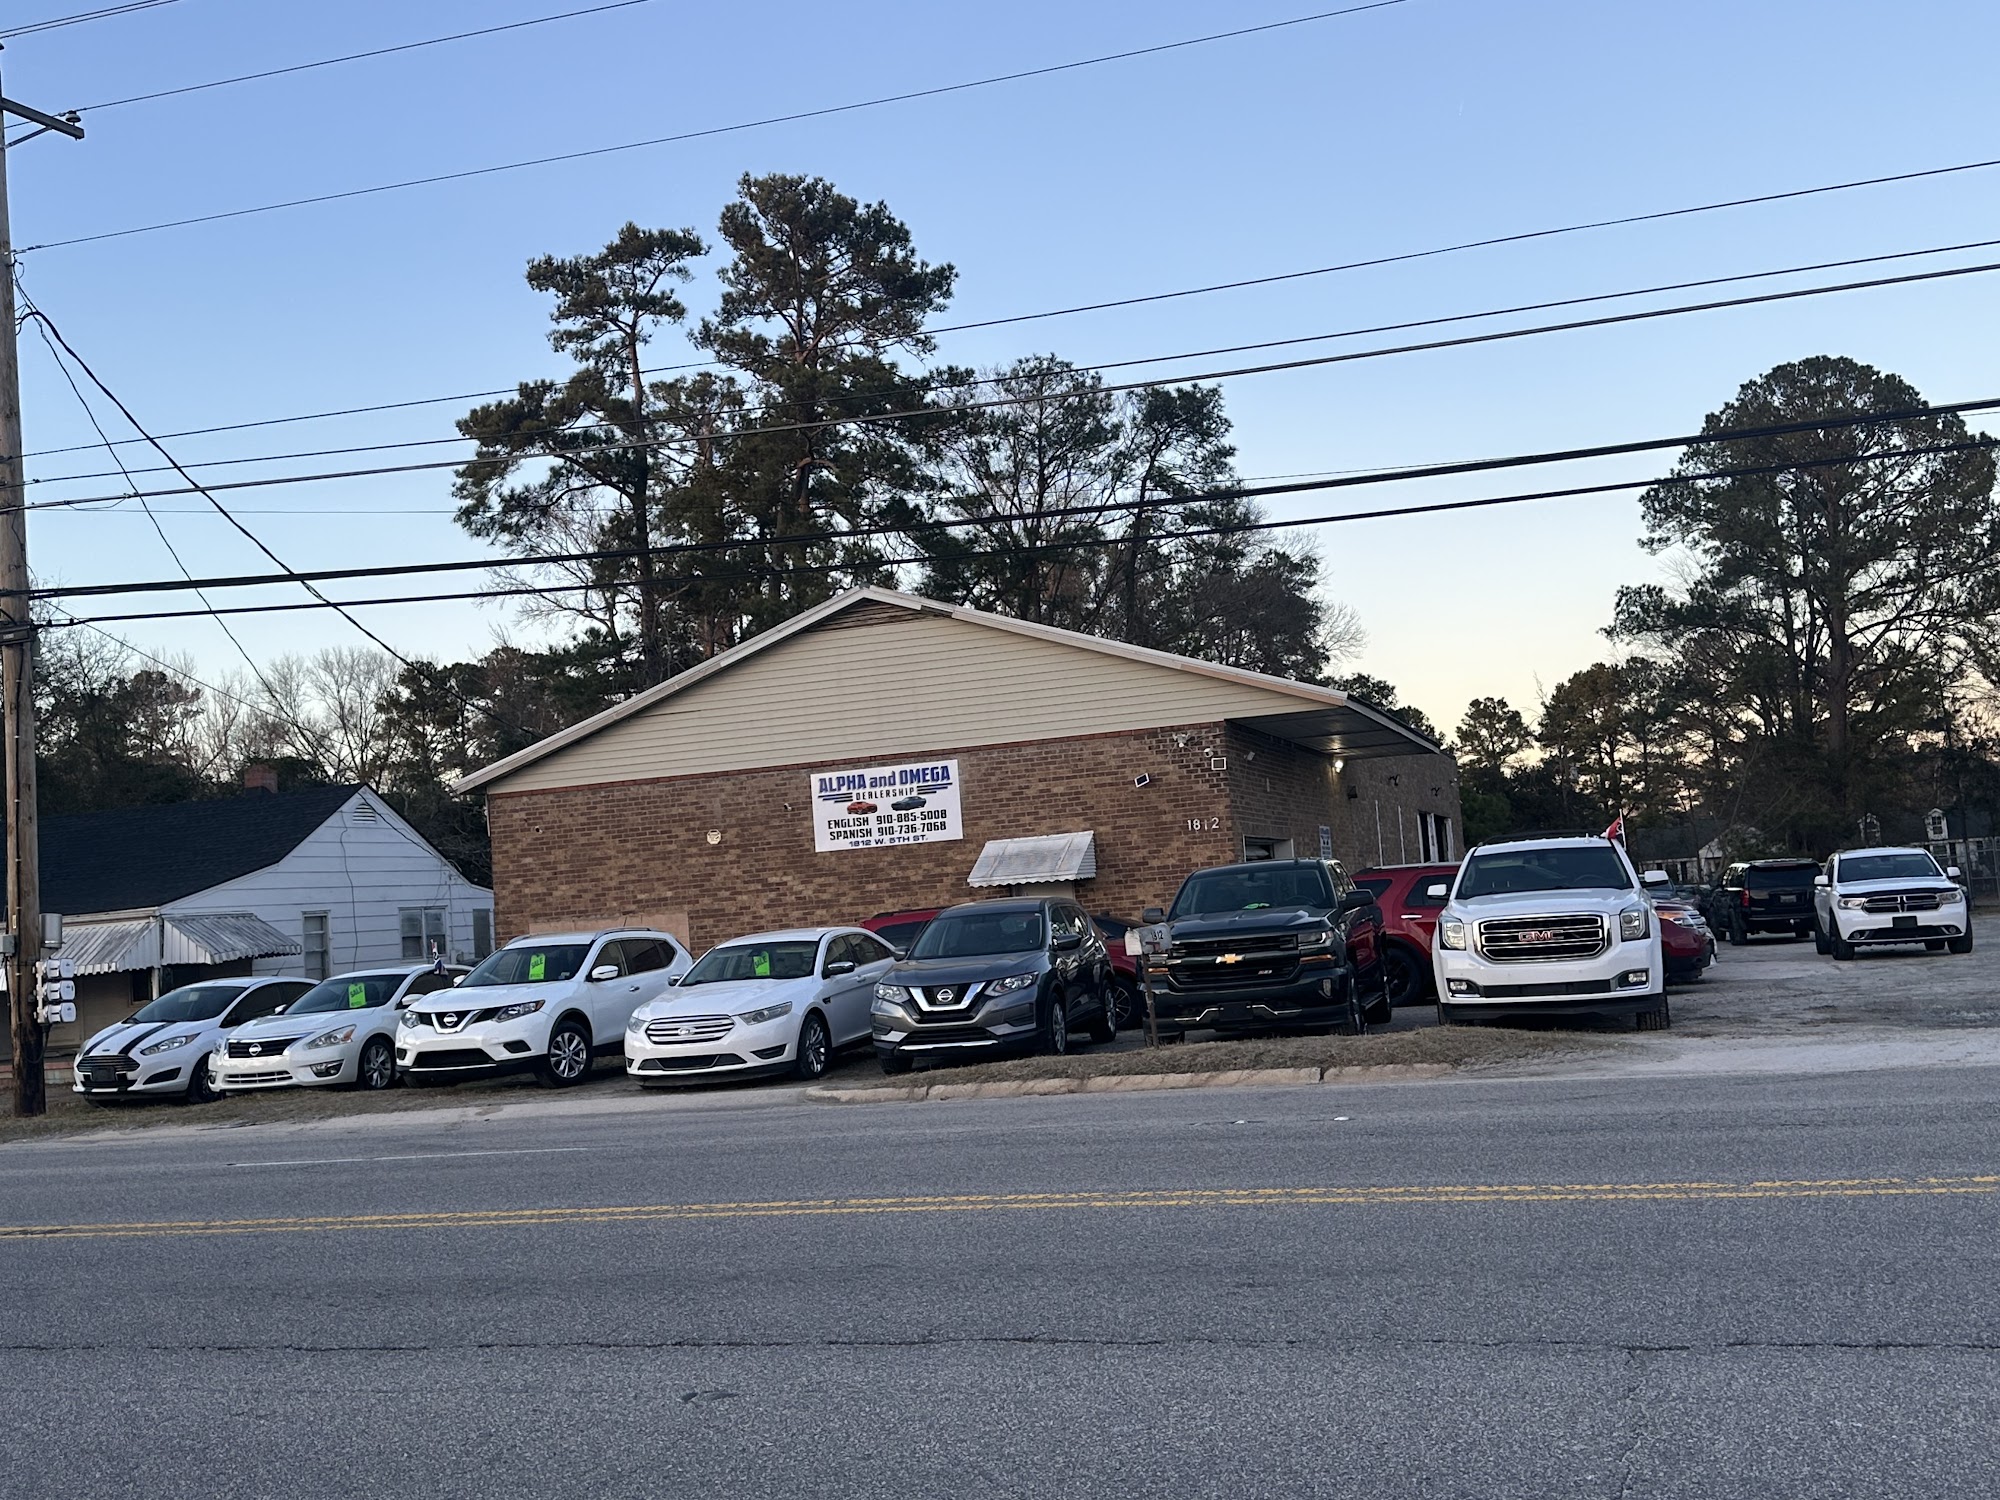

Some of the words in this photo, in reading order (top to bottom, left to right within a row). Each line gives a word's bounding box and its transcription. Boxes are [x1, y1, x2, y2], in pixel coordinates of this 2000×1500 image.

[818, 774, 867, 793] ALPHA
[869, 771, 896, 788] and
[899, 765, 951, 785] OMEGA
[855, 787, 915, 801] DEALERSHIP
[827, 817, 869, 829] ENGLISH
[876, 809, 947, 825] 910-885-5008
[1187, 816, 1220, 831] 1812
[829, 828, 873, 841] SPANISH
[877, 821, 947, 836] 910-736-7068
[848, 839, 872, 847] 1812
[874, 837, 886, 845] W.
[889, 836, 910, 844] 5TH
[1518, 930, 1565, 941] GMC
